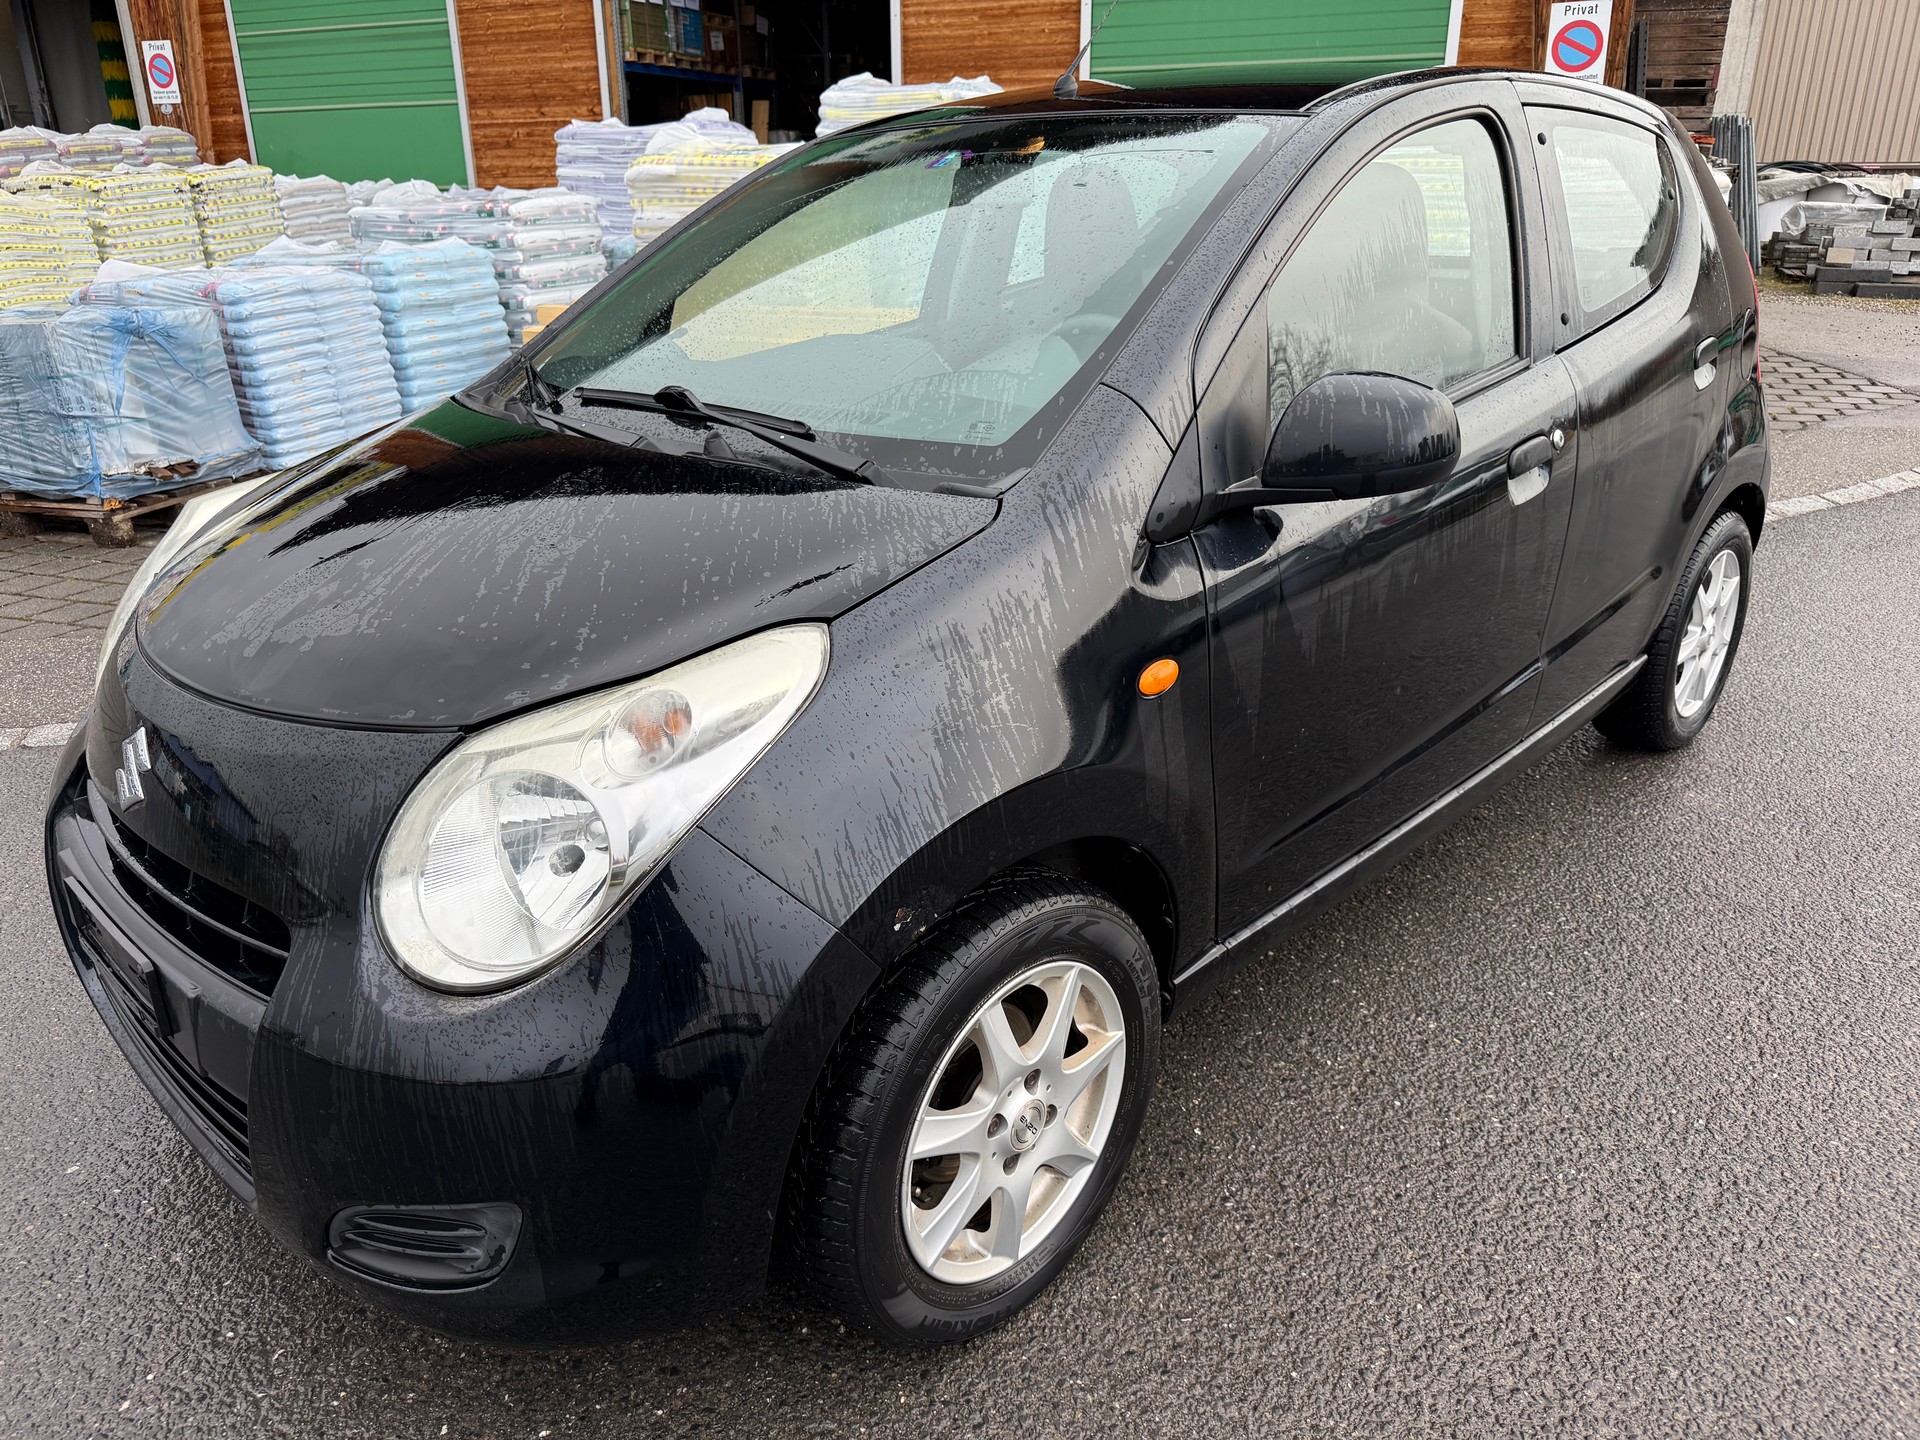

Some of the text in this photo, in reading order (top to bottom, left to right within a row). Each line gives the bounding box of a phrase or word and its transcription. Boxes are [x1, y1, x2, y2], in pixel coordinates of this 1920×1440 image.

[1564, 4, 1599, 16] Privat
[148, 43, 166, 51] Privat
[1019, 1114, 1038, 1135] ENZO
